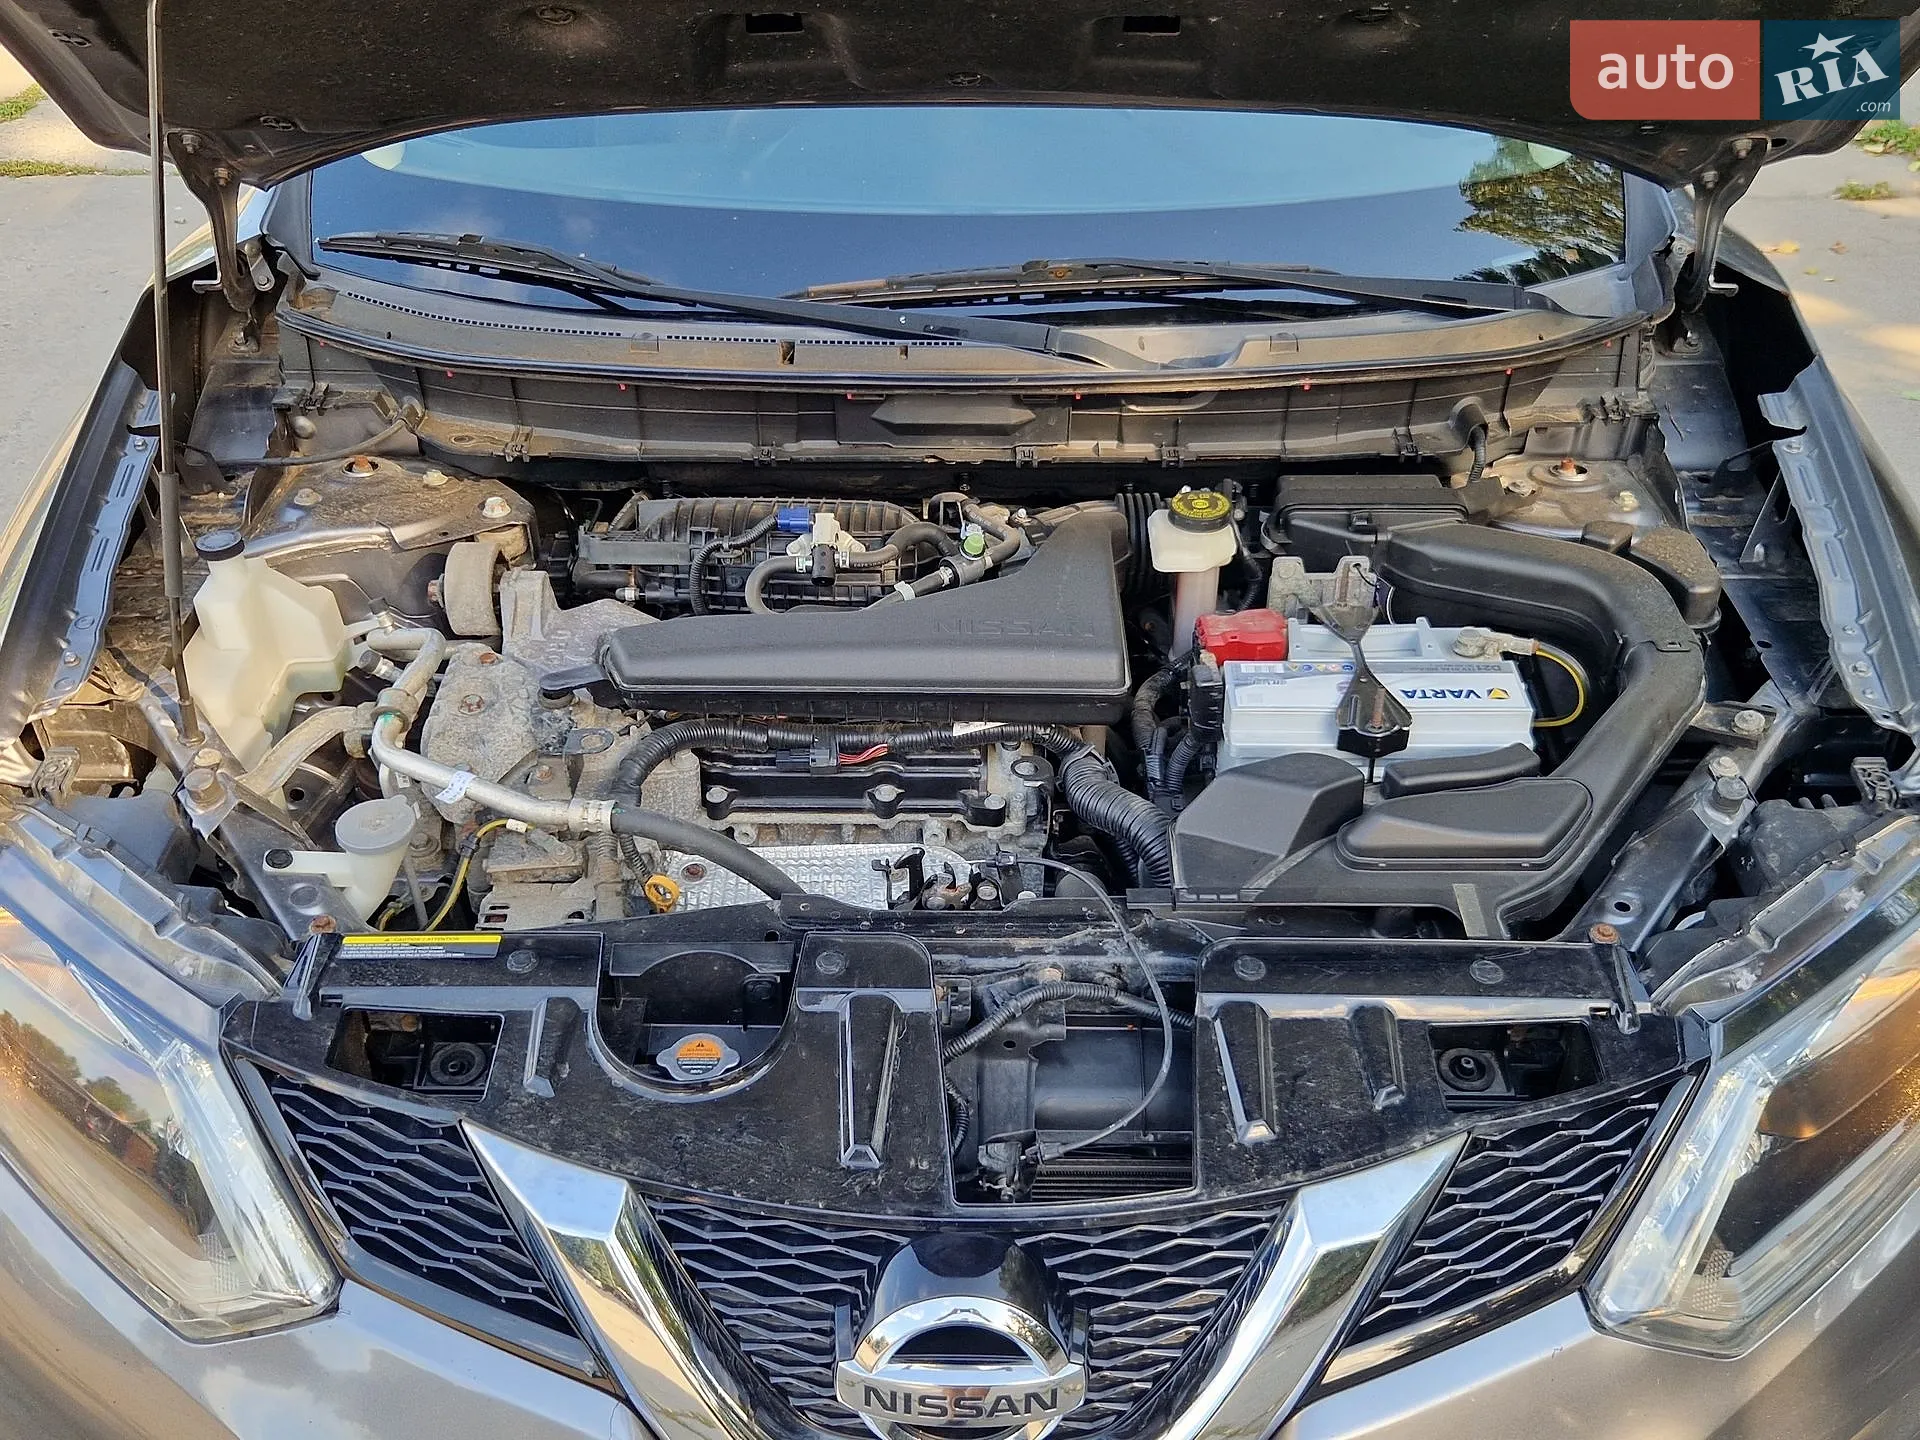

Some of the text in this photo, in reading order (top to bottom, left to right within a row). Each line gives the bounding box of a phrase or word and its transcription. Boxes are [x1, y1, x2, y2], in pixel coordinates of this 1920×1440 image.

[936, 619, 1095, 637] NISSAN
[1402, 688, 1482, 700] VARTA
[864, 1384, 1058, 1418] NISSAN
